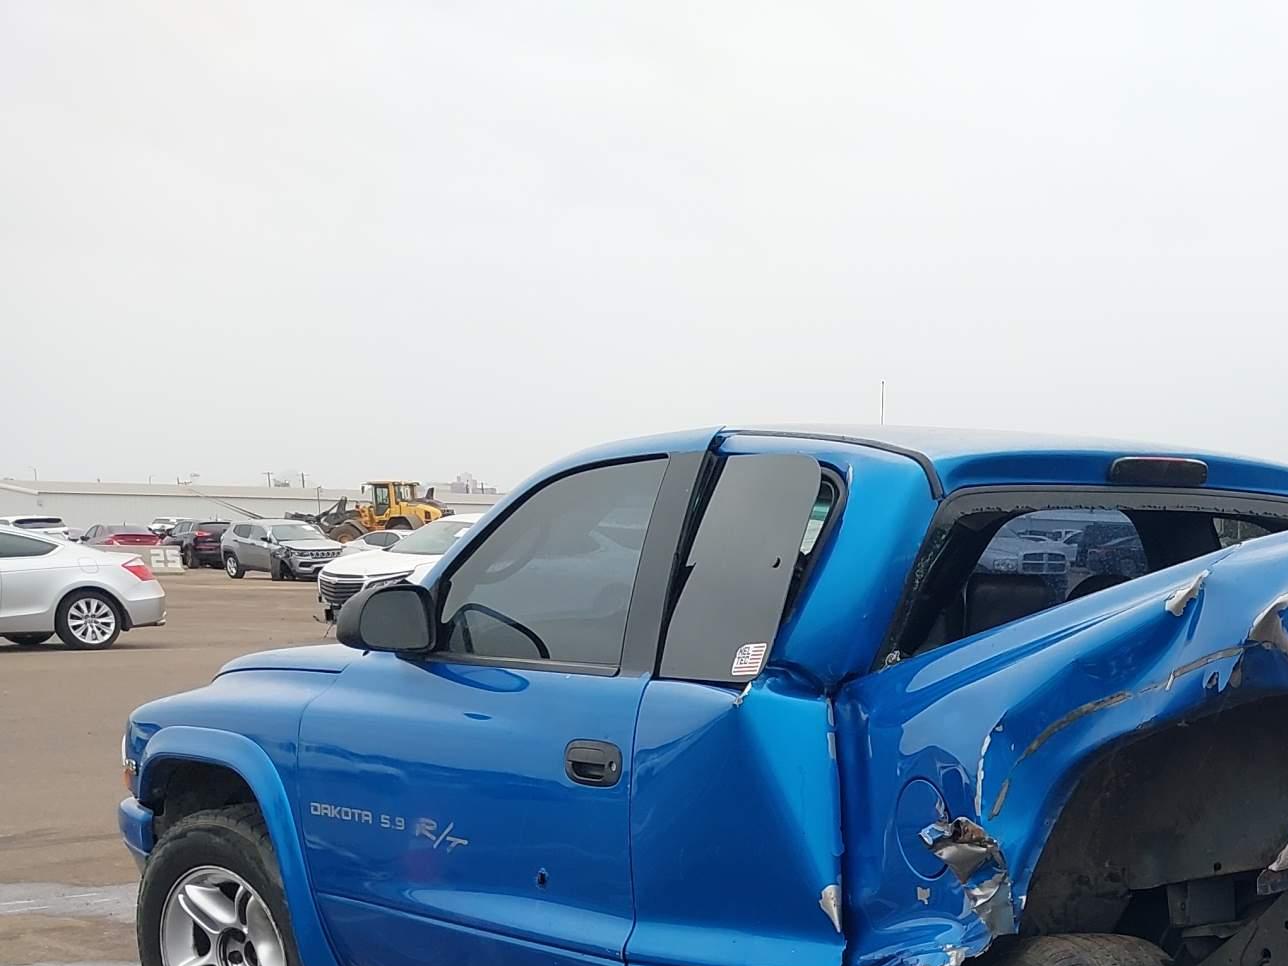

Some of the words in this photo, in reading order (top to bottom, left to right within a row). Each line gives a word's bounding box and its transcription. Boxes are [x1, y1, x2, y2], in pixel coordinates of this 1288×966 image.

[150, 549, 180, 568] 25
[310, 802, 373, 824] DAKOTA
[380, 814, 405, 831] 5.9
[415, 817, 469, 853] R/T
